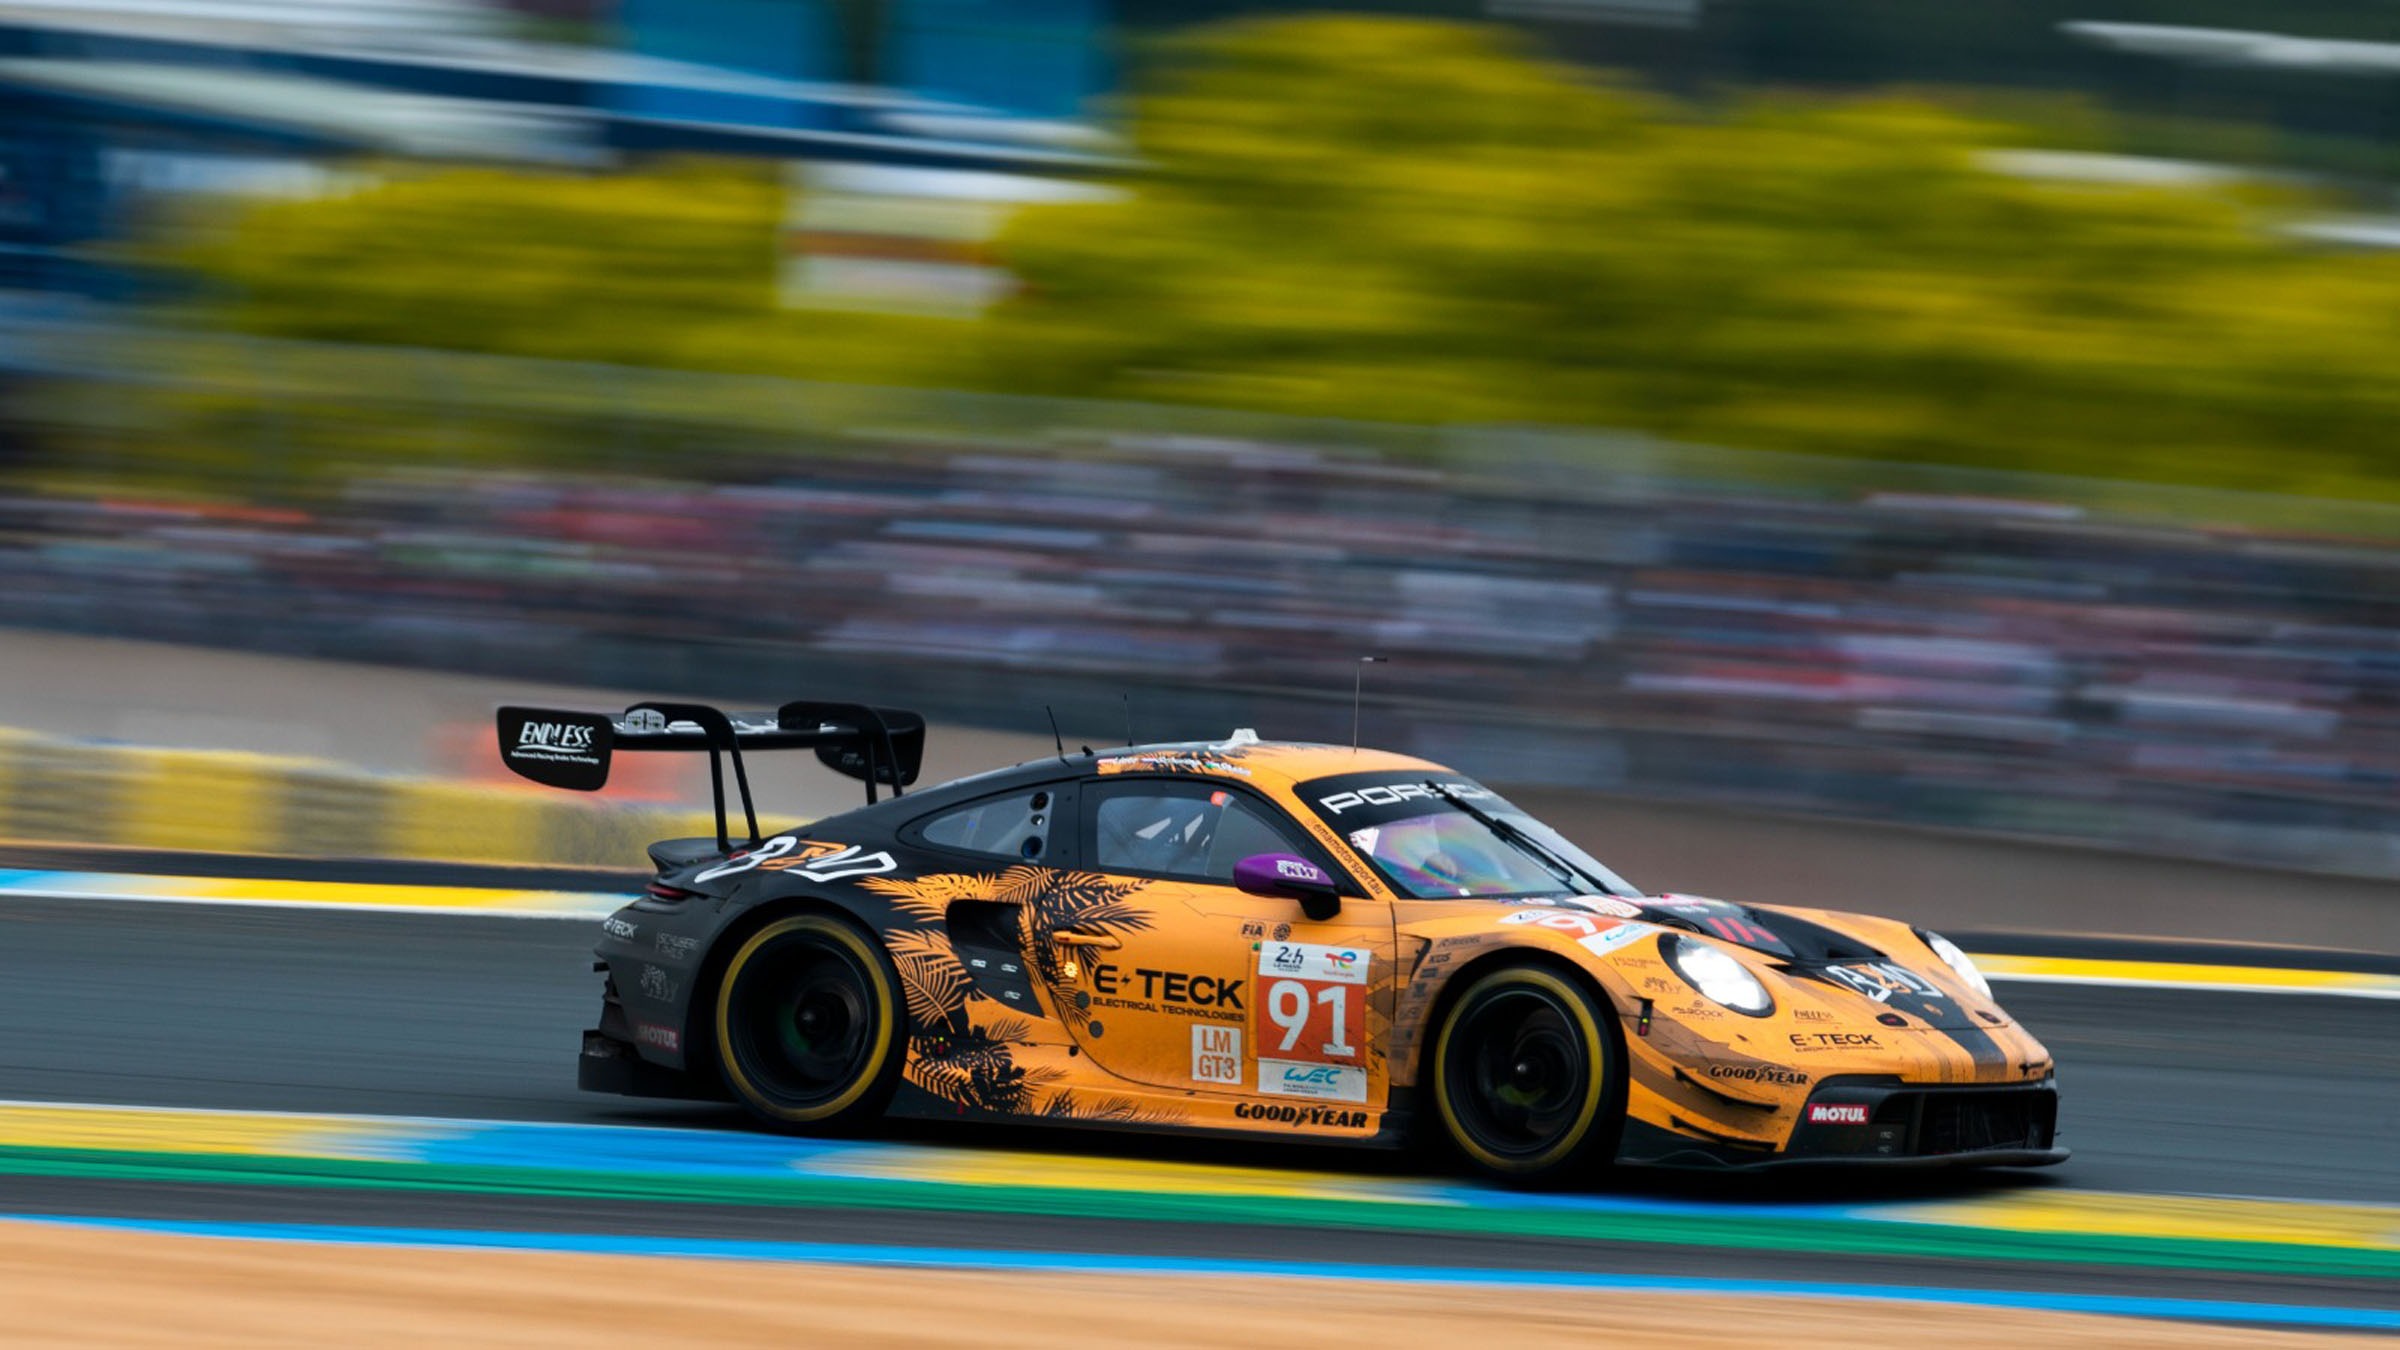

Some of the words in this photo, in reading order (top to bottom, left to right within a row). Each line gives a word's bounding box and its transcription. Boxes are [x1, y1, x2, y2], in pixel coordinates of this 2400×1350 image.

[1242, 924, 1263, 936] FIA
[1093, 997, 1158, 1013] ELECTRICAL
[1162, 1004, 1245, 1022] TECHNOLOGIES
[1268, 979, 1355, 1057] 91
[1202, 1028, 1231, 1053] LM
[1199, 1055, 1236, 1080] GT3
[1283, 1066, 1342, 1084] WEC
[1710, 1065, 1808, 1085] GOODYEAR
[1234, 1103, 1368, 1128] GOODYEAR
[1811, 1106, 1866, 1122] MOTUL
